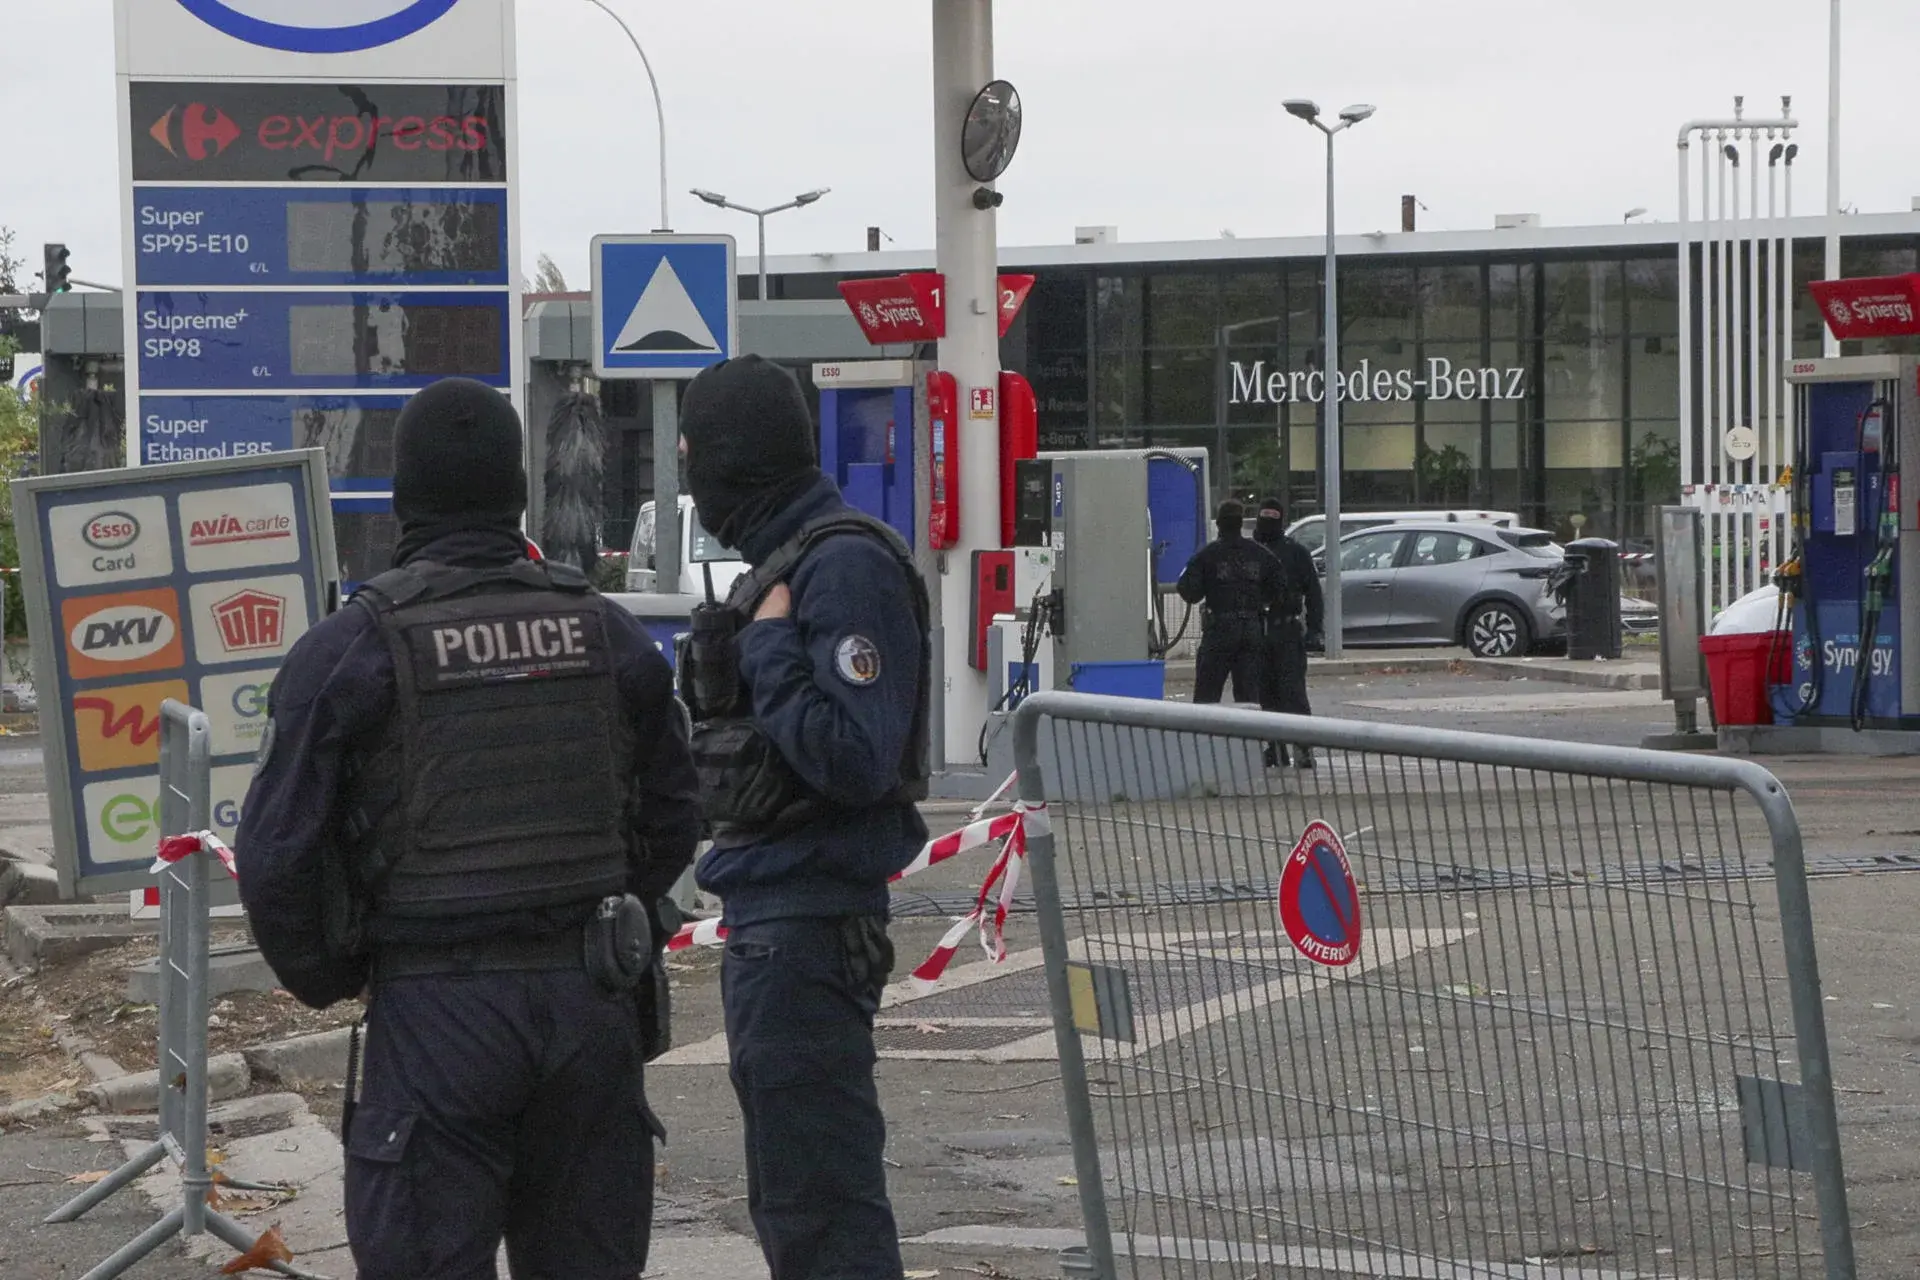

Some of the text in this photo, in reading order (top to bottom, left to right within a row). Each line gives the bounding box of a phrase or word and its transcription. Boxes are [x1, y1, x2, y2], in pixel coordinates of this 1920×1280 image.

[257, 112, 488, 162] express
[141, 206, 204, 227] Super
[142, 234, 249, 254] SP95-E10
[931, 289, 941, 308] 1
[1003, 290, 1015, 309] 2
[877, 303, 924, 328] Synerg
[1851, 300, 1913, 323] Synergy
[144, 339, 201, 358] SP98
[822, 367, 840, 377] ESSO
[1793, 363, 1815, 374] ESSO
[1229, 357, 1526, 404] Mercedes-Benz
[146, 416, 208, 438] Super
[148, 442, 227, 462] Ethanol
[246, 514, 290, 532] carte
[92, 553, 136, 572] Card
[219, 594, 280, 647] UTA
[82, 615, 163, 651] DKV
[432, 617, 586, 667] POLICE
[1824, 640, 1892, 675] Syngy
[1300, 934, 1351, 961] INTERDIT
